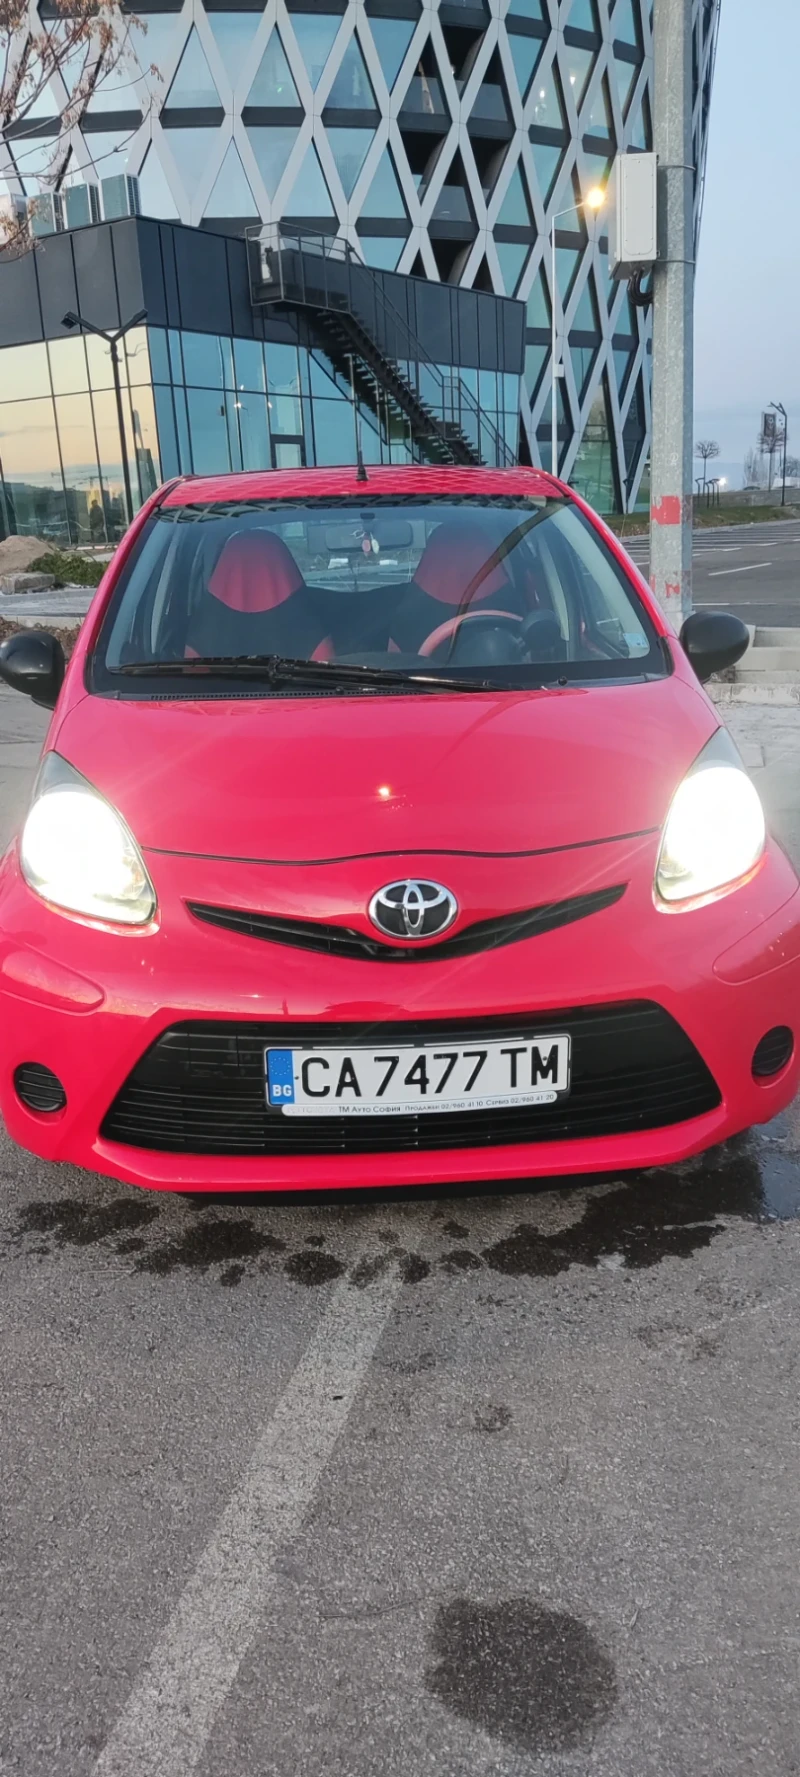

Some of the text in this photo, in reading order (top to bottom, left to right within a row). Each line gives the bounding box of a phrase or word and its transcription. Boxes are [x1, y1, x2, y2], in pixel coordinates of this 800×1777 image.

[301, 1044, 559, 1098] CA 7477 TM
[272, 1084, 292, 1097] BG
